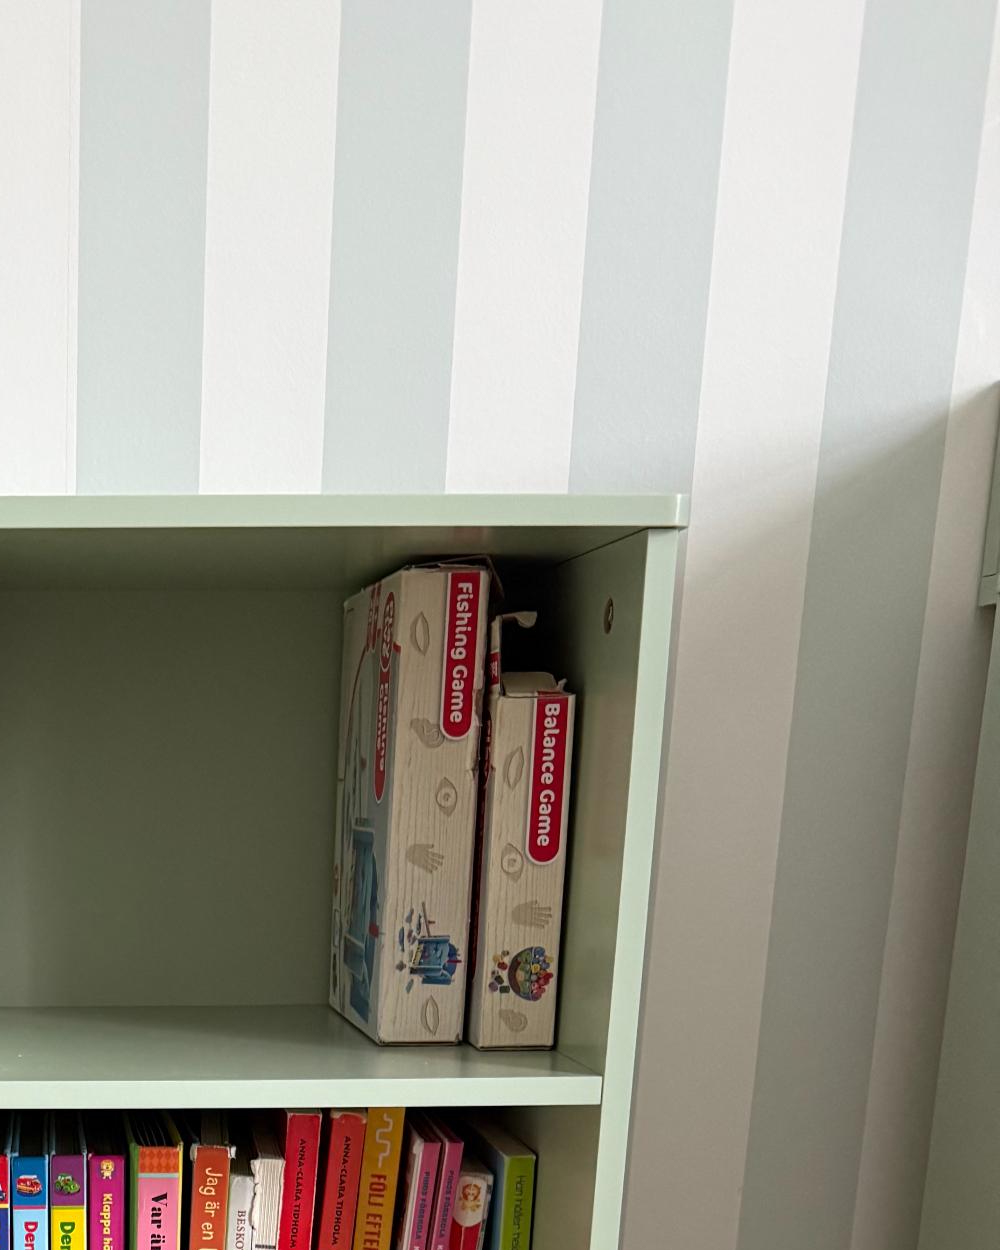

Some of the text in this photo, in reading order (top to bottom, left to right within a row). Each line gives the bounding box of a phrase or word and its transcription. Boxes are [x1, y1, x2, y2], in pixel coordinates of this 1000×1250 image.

[449, 582, 473, 723] Fishing Game
[537, 703, 561, 847] Balance Game
[198, 1167, 223, 1196] Jag
[294, 1138, 307, 1201] ANNA-CLARA
[336, 1136, 352, 1199] ANNA-CLARA
[515, 1175, 527, 1196] Han
[100, 1193, 113, 1235] Klappa
[151, 1192, 168, 1229] Var
[201, 1222, 215, 1240] en
[204, 1201, 220, 1217] är
[289, 1203, 301, 1249] TIDHOLM
[331, 1200, 344, 1246] TIDHOLM
